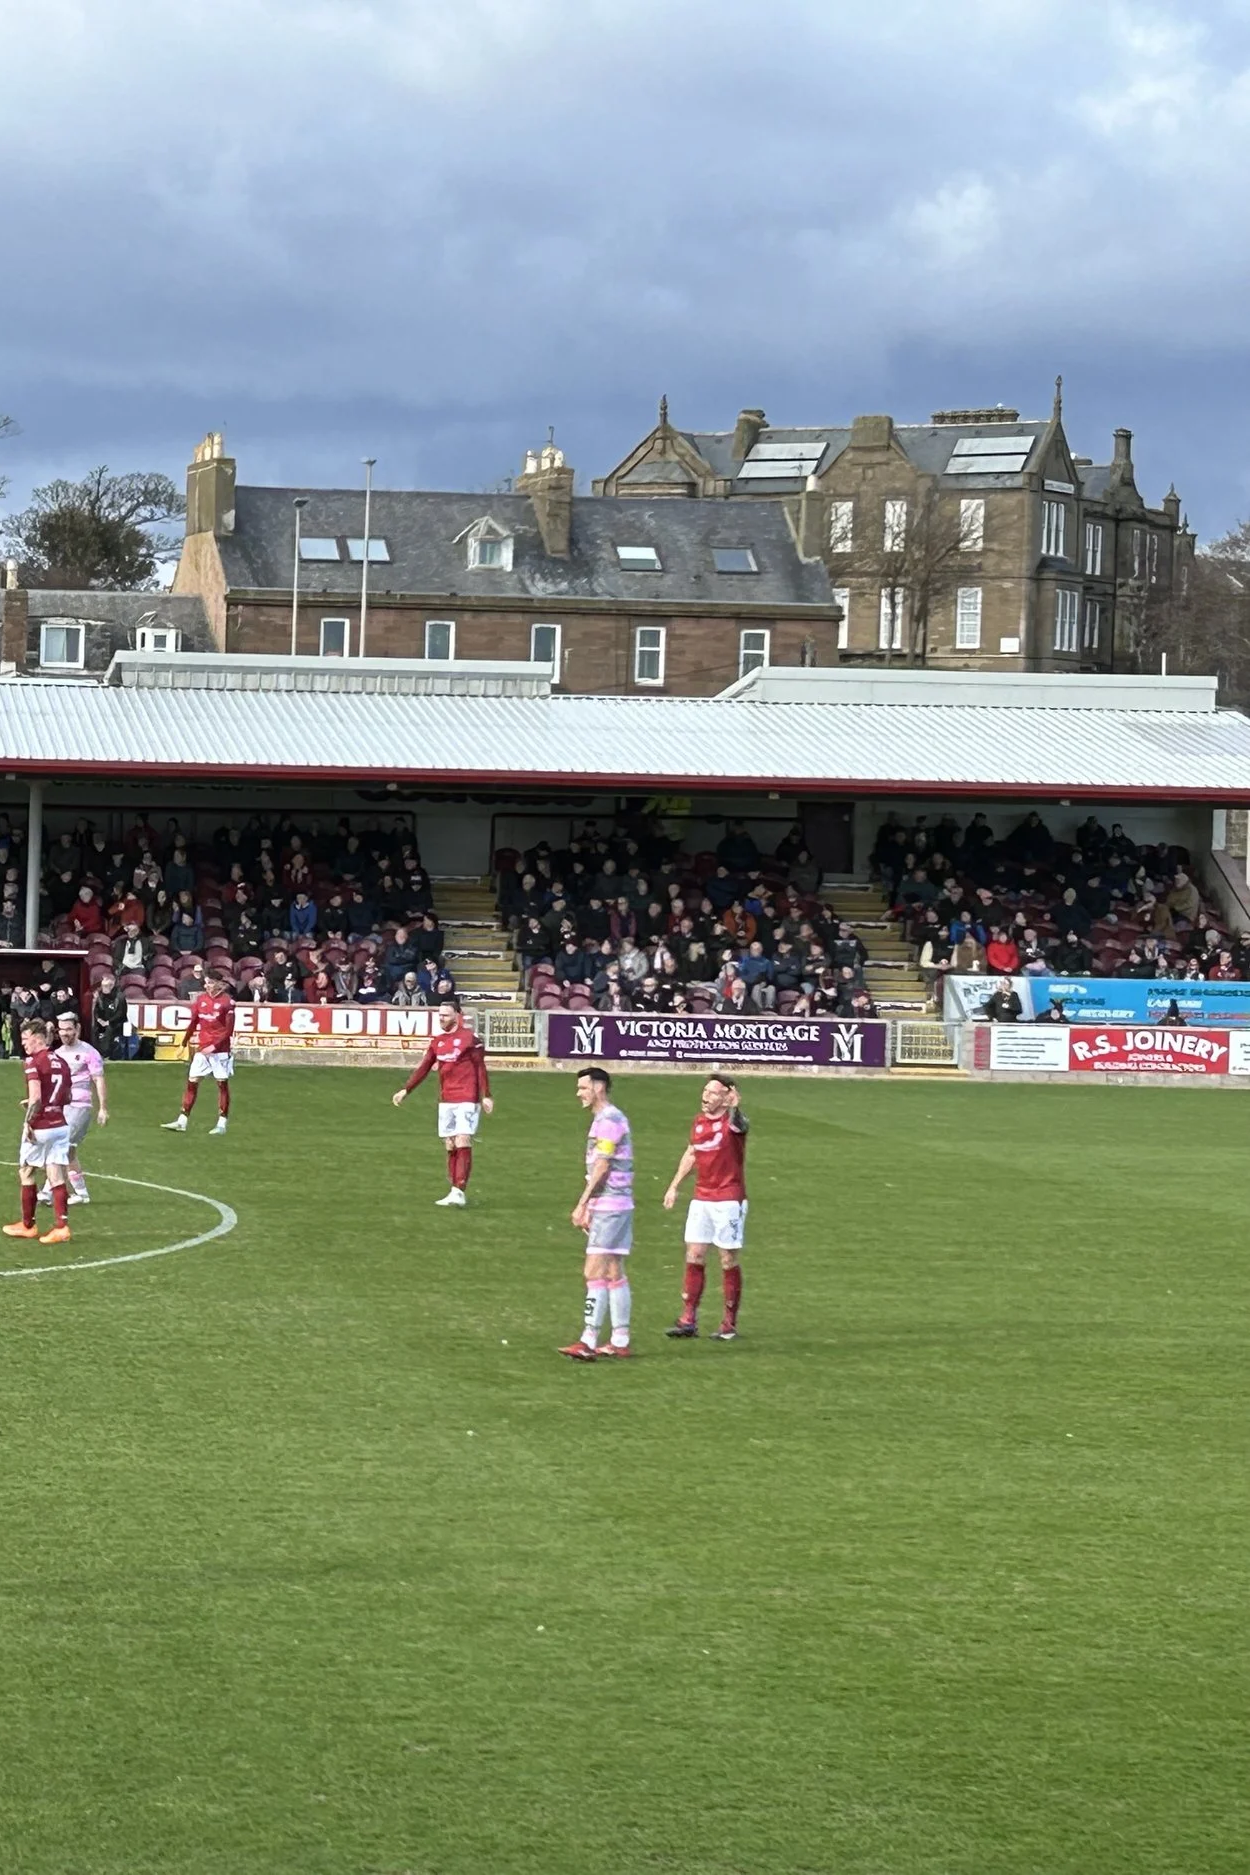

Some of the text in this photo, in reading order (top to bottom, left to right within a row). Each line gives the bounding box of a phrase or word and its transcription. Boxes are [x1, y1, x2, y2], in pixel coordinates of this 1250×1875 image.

[290, 1008, 320, 1034] &
[615, 1020, 820, 1042] VICTORIA MORTGAGE
[1072, 1034, 1119, 1061] R.S.
[1122, 1031, 1228, 1063] JOINERY
[49, 1073, 64, 1104] 7
